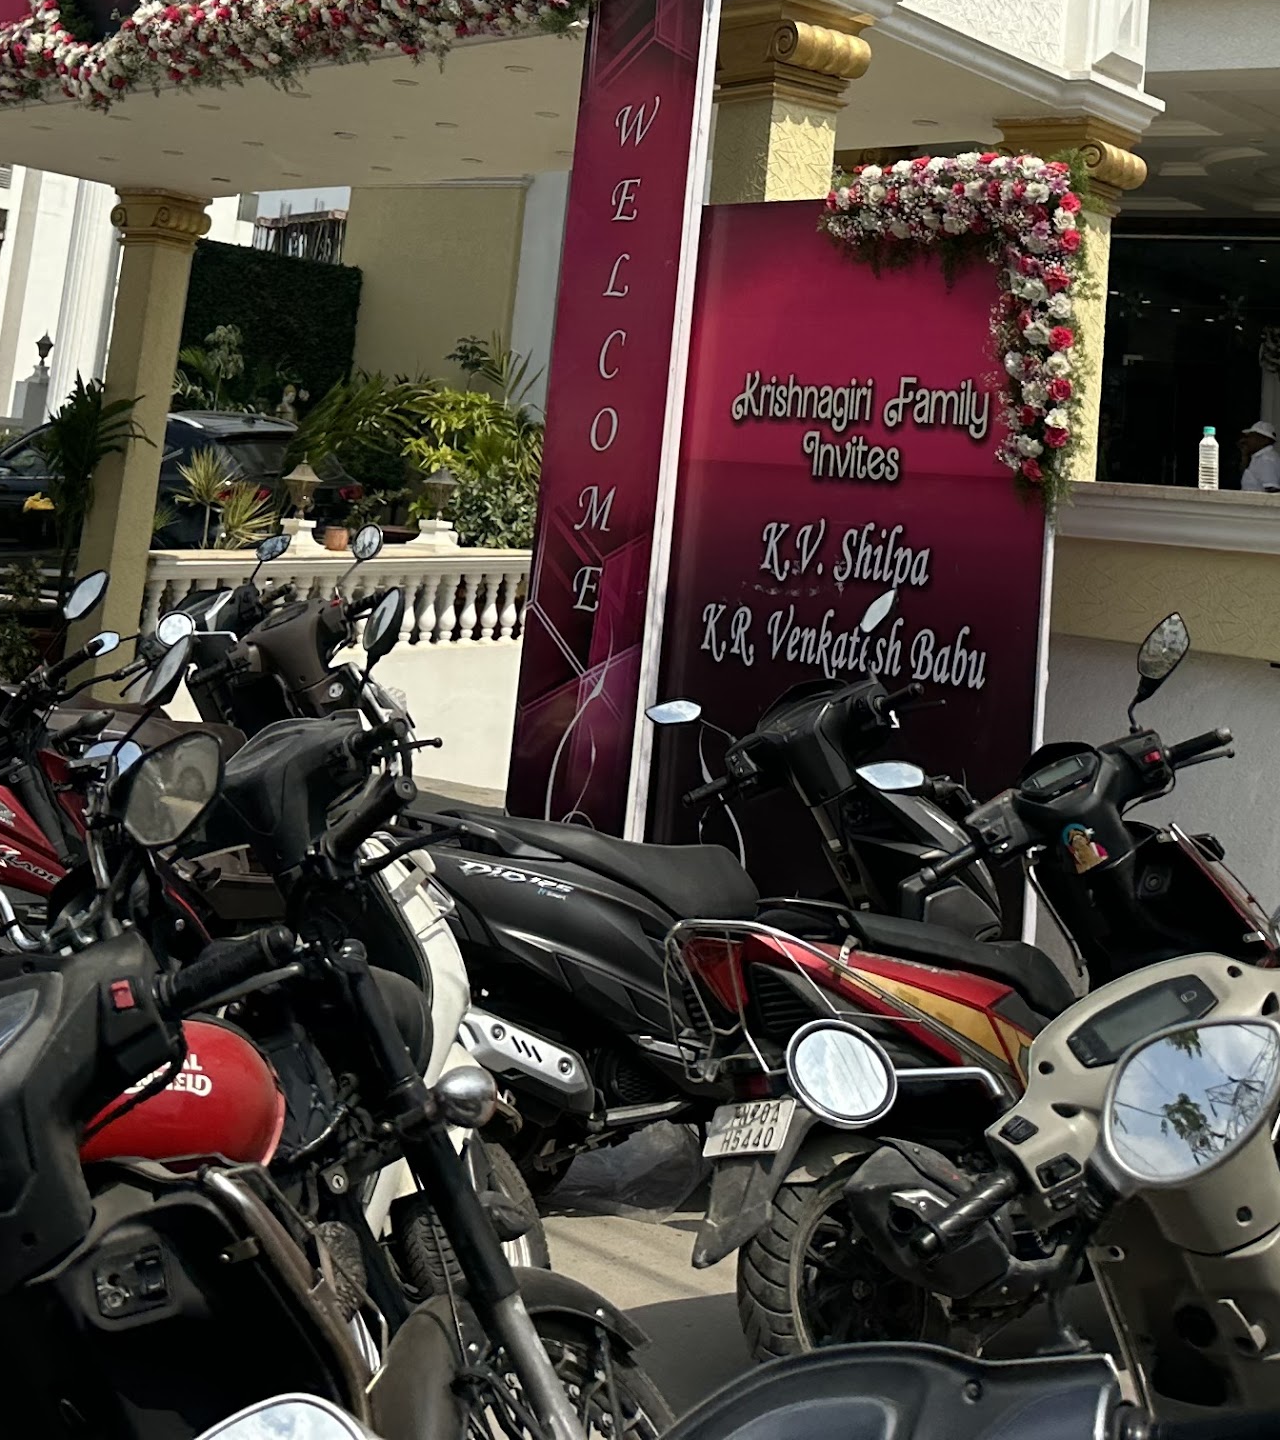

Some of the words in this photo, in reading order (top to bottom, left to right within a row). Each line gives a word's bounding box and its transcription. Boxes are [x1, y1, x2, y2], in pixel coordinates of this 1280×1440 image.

[572, 95, 662, 613] WELCOME
[731, 370, 874, 433] Krishnagiri
[883, 376, 991, 439] Family
[802, 430, 900, 481] Invites
[758, 518, 826, 582] K.V.
[833, 521, 931, 588] Shilpa
[910, 625, 988, 690] Babu
